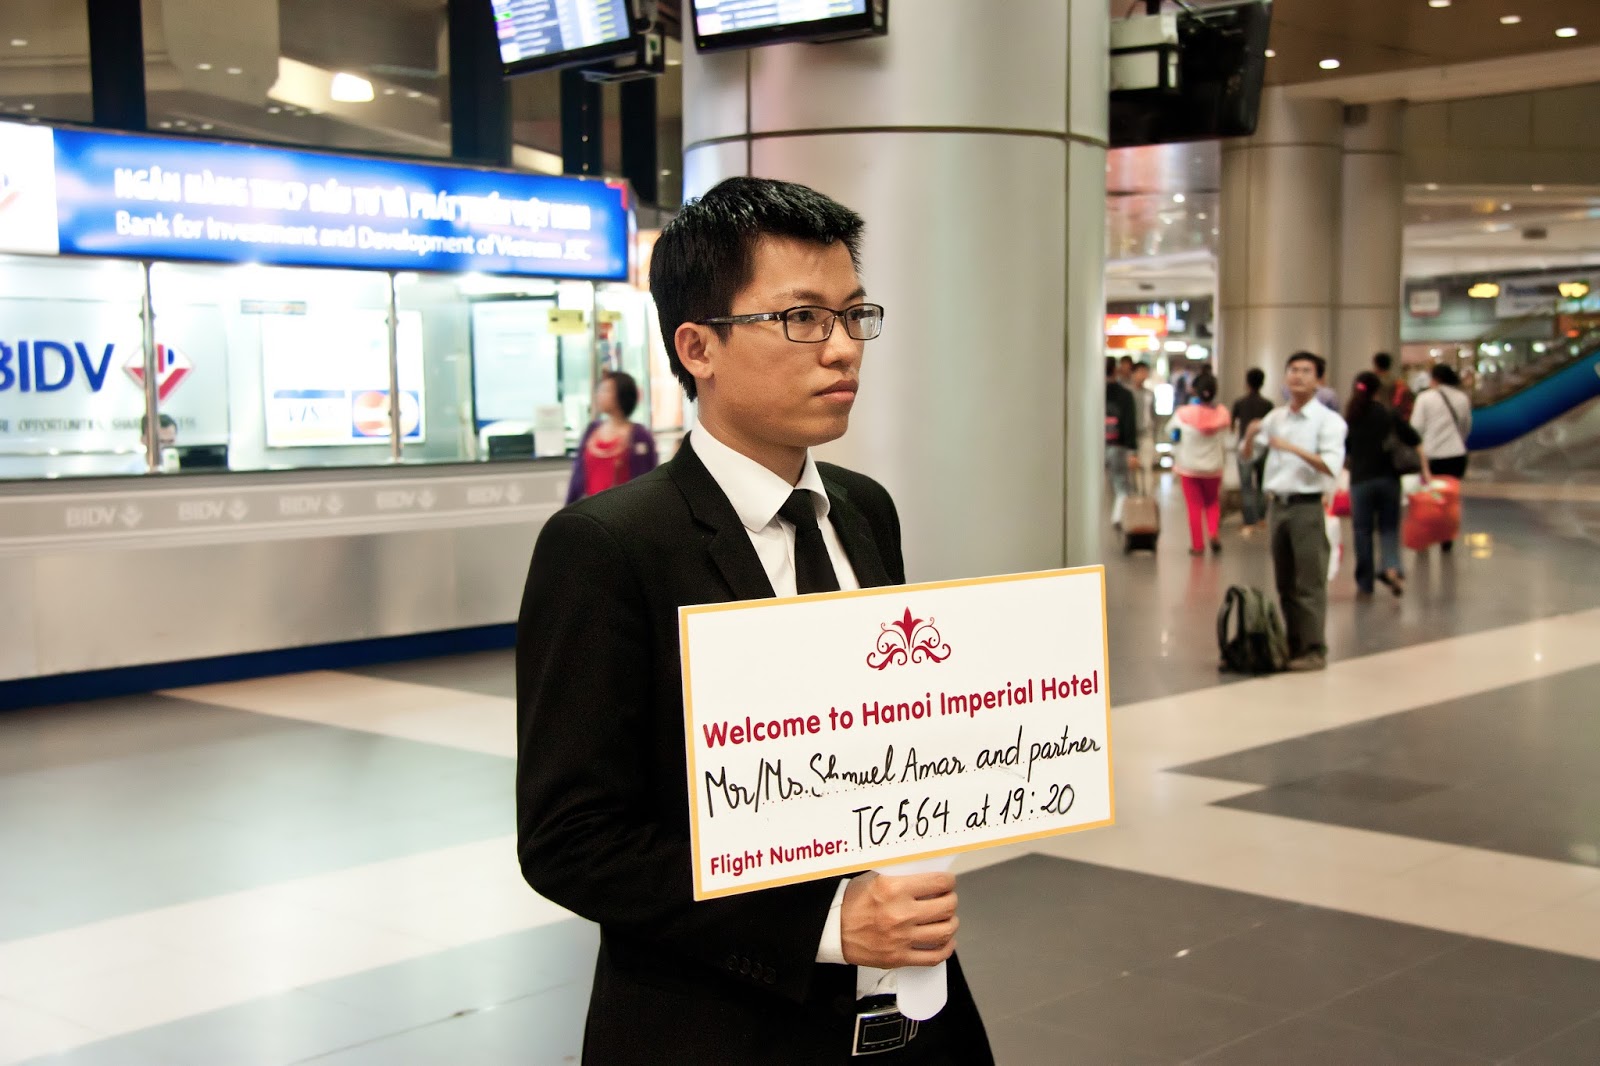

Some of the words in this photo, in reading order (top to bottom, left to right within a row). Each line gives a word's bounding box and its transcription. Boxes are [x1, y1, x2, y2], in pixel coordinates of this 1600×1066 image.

[115, 210, 171, 237] Bank
[172, 213, 204, 239] for
[207, 216, 317, 246] Investment
[320, 225, 355, 248] and
[358, 226, 475, 256] Development
[476, 235, 494, 256] of
[493, 235, 562, 259] Vietnam
[0, 341, 115, 392] BIDV
[66, 507, 116, 528] BIDV
[178, 501, 226, 521] BIDV
[280, 496, 321, 514] BIDV
[703, 716, 821, 748] Welcome
[829, 707, 854, 732] to
[862, 692, 932, 727] Hanoi
[940, 678, 1033, 718] Imperial
[1041, 669, 1099, 701] Hotel
[809, 744, 896, 797] Shmuel
[900, 747, 966, 783] Amar
[976, 724, 1023, 769] and
[1027, 724, 1101, 783] partner
[966, 793, 990, 829] at
[710, 849, 763, 876] Flight
[770, 838, 849, 865] Number:
